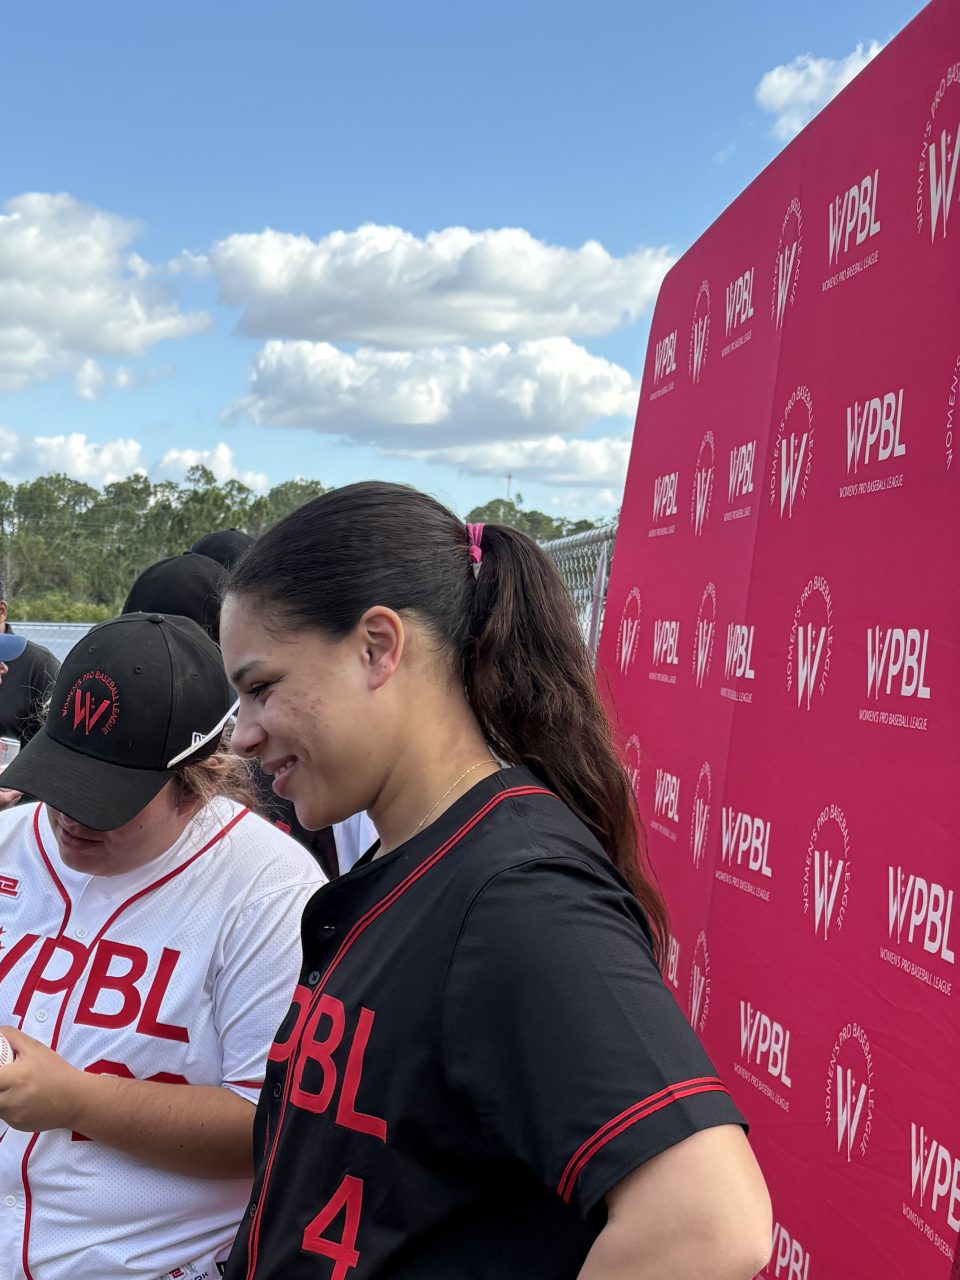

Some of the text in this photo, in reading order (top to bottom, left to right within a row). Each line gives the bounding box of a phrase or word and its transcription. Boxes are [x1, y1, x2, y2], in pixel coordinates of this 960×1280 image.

[931, 78, 946, 119] PRO
[828, 169, 880, 268] WPBL
[726, 266, 754, 338] WPBL
[654, 330, 678, 385] WPBL
[846, 388, 906, 474] WPBL
[652, 472, 679, 523] WPBL
[728, 440, 757, 504] WPBL
[840, 474, 904, 498] WOMEN'S PRO BASEBALL LEAGUE
[653, 618, 680, 667] WPBL
[724, 622, 755, 680] WPBL
[787, 575, 834, 697] WOMEN'S PRO BASEBALL LEAGUE
[867, 625, 931, 701] WPBL
[94, 670, 119, 702] BASEBALL
[101, 702, 120, 735] LEAGUE
[859, 709, 928, 731] WOMEN'S PRO BASEBALL LEAGUE
[654, 768, 681, 823] WPBL
[722, 806, 772, 878] WPBL
[803, 803, 851, 931] WOMEN'S PRO BASEBALL LEAGUE
[889, 865, 955, 965] WPBL
[880, 947, 952, 997] WOMEN'S PRO BASEBALL LEAGUE
[740, 1000, 791, 1088] WPBL
[825, 1022, 874, 1157] WOMEN'S PRO BASEBALL LEAGUE
[902, 1202, 924, 1232] WOMEN'S
[924, 1224, 934, 1242] PRO
